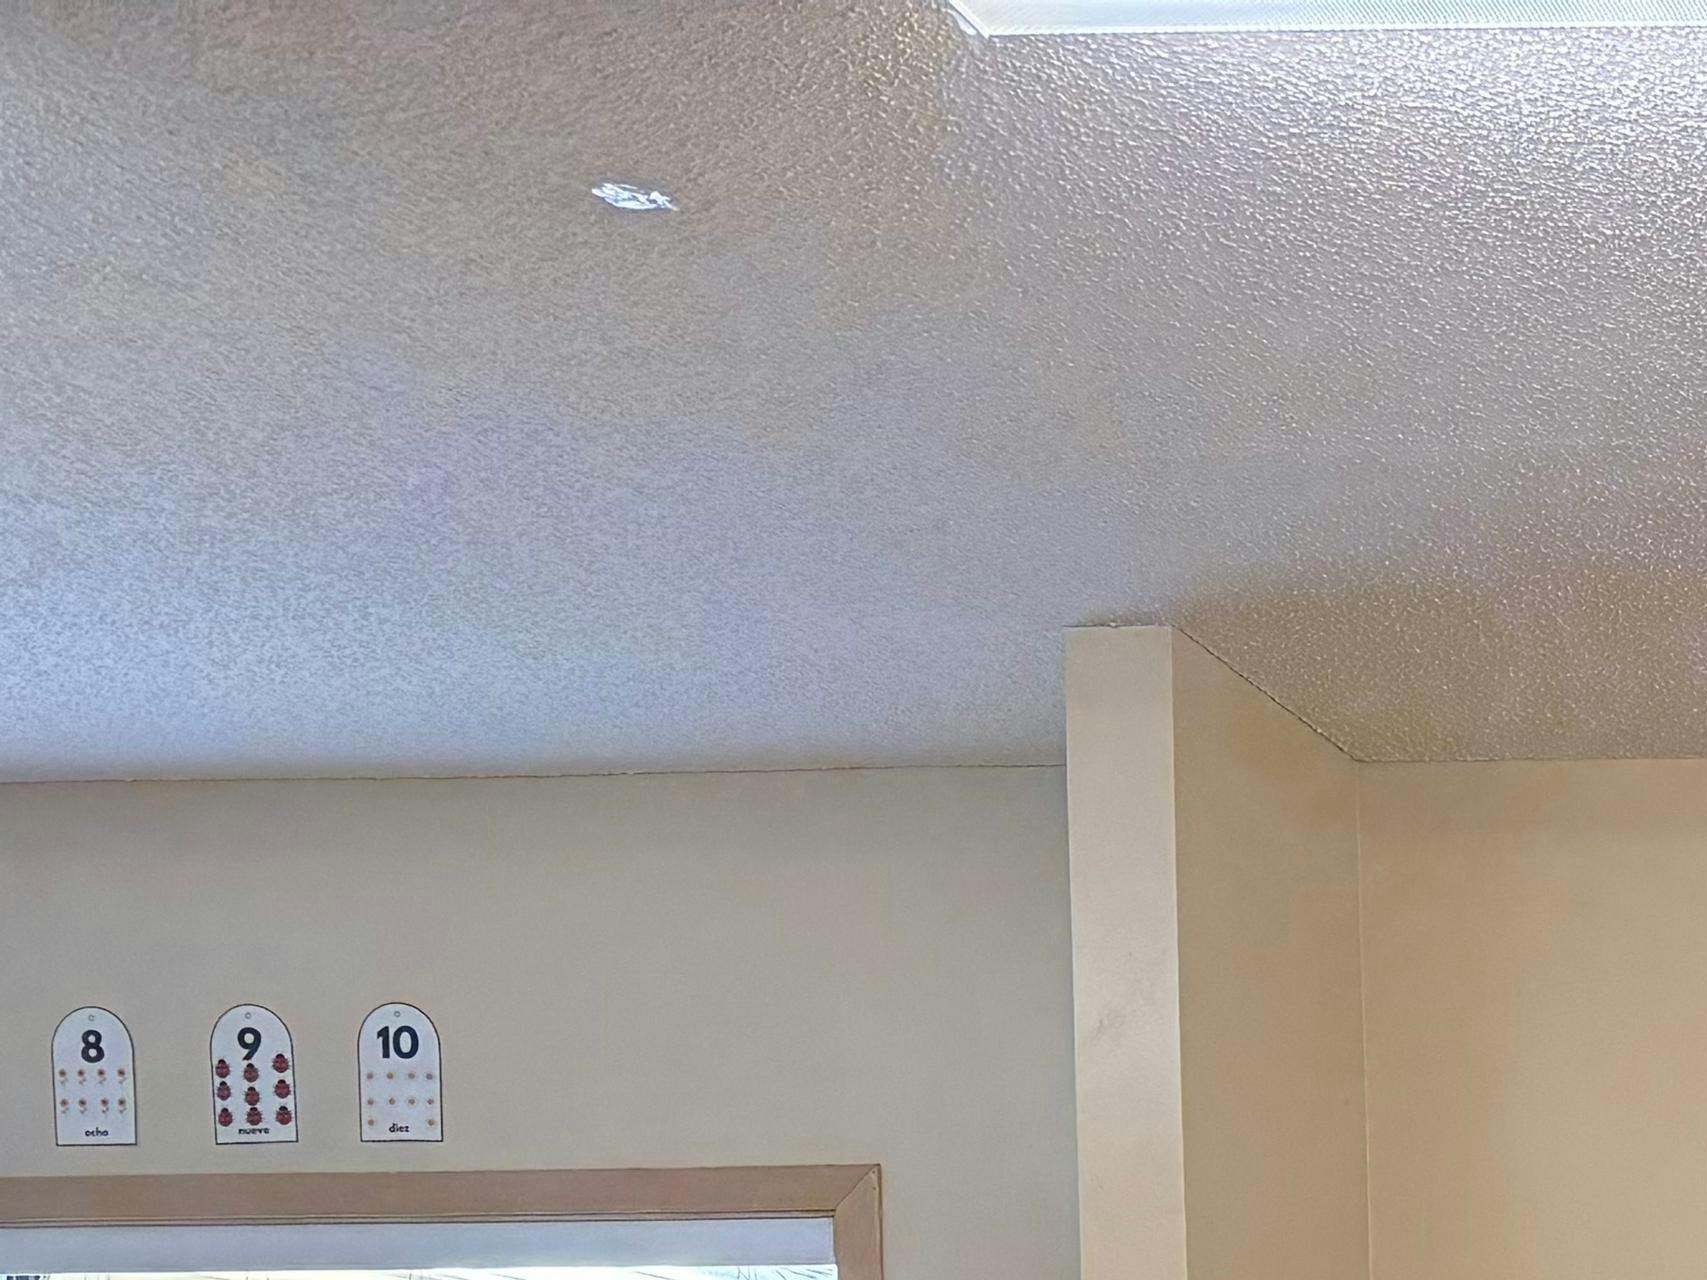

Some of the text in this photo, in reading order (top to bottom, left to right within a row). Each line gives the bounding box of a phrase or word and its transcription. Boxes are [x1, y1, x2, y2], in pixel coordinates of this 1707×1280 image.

[80, 1029, 105, 1063] 8
[237, 1027, 262, 1061] 9
[376, 1025, 419, 1060] 10
[84, 1126, 109, 1137] ocho
[388, 1121, 411, 1134] diez
